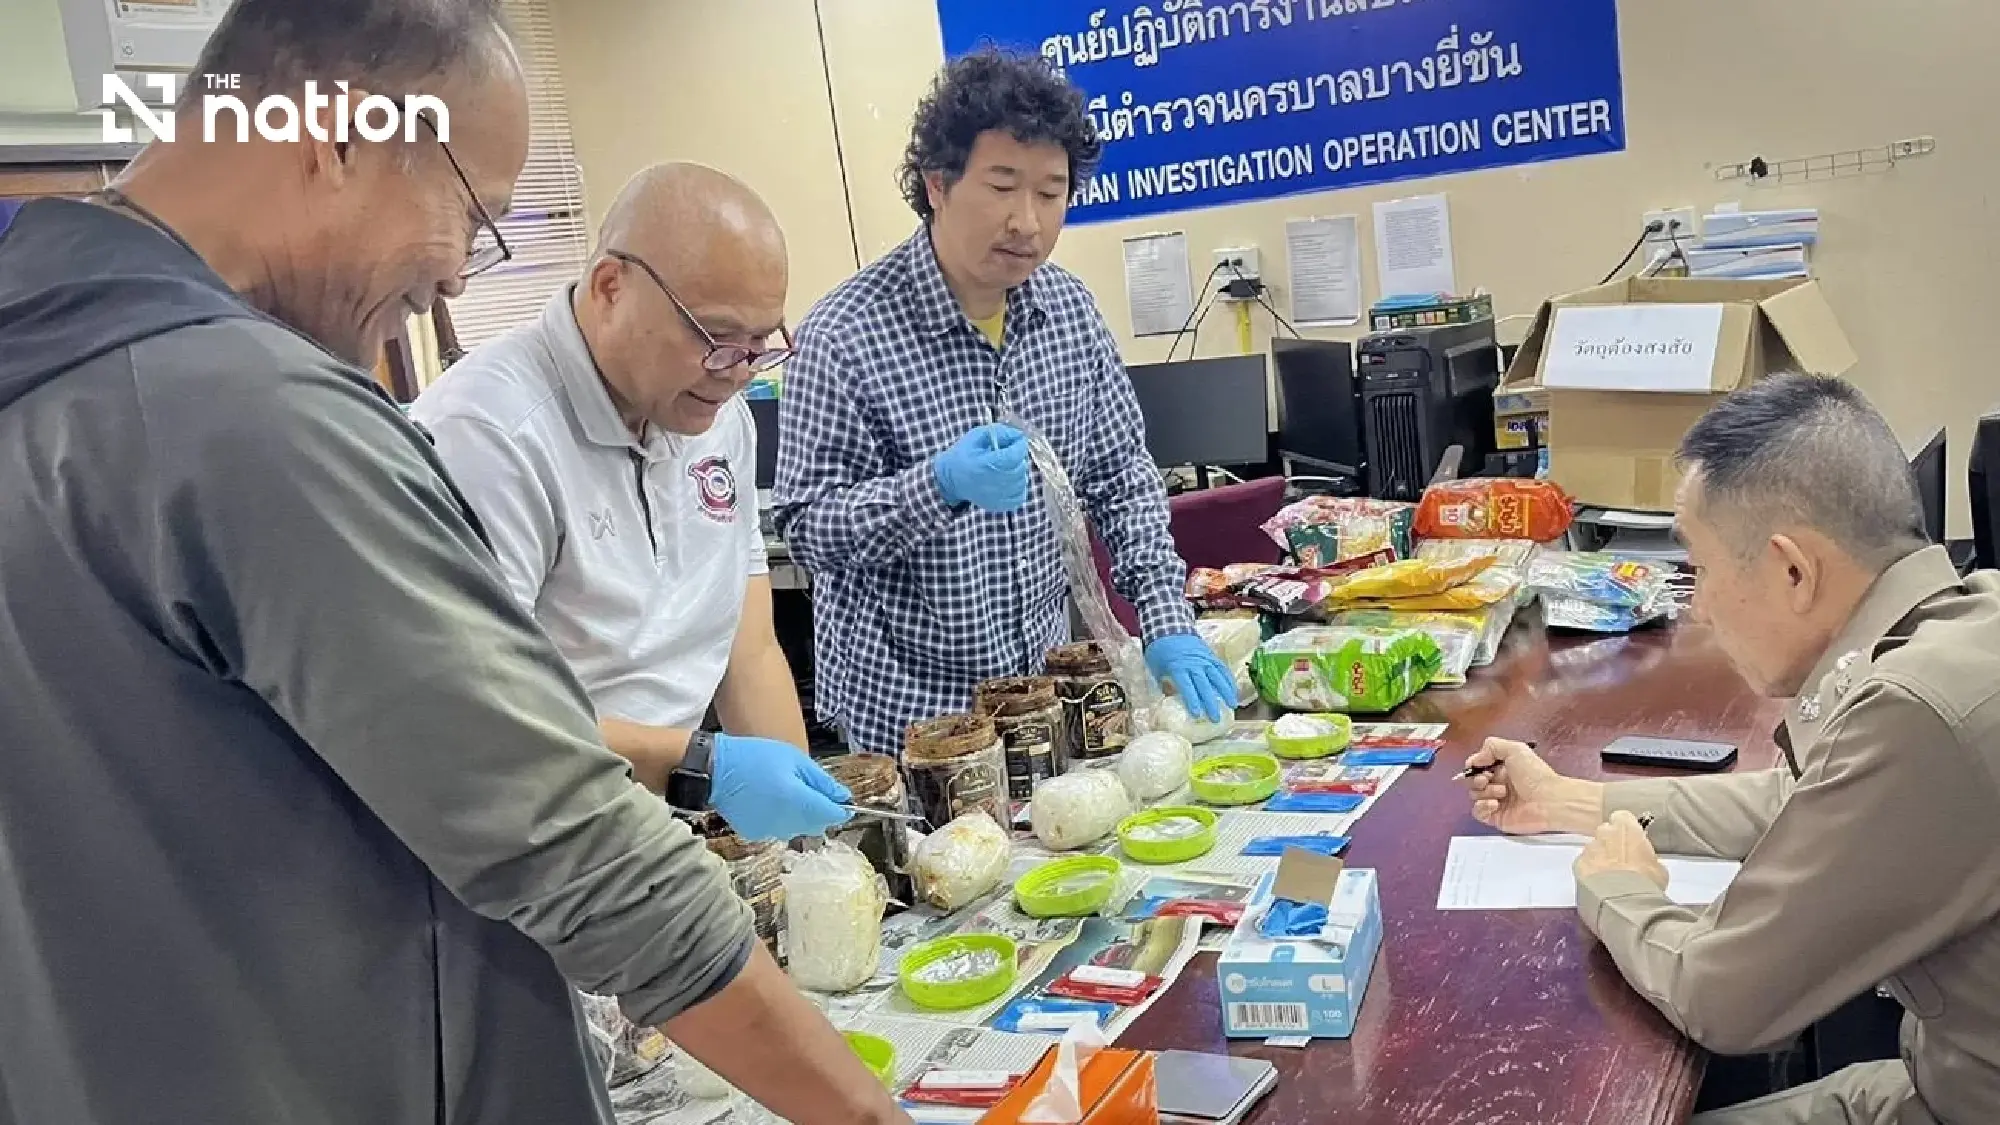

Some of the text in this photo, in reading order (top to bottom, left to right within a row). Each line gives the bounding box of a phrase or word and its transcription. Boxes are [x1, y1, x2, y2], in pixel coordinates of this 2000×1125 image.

[1087, 24, 1523, 141] นีตำรวจนครบาลบางยี่ขัน
[1069, 99, 1611, 208] HAN INVESTIGATION OPERATION CENTER
